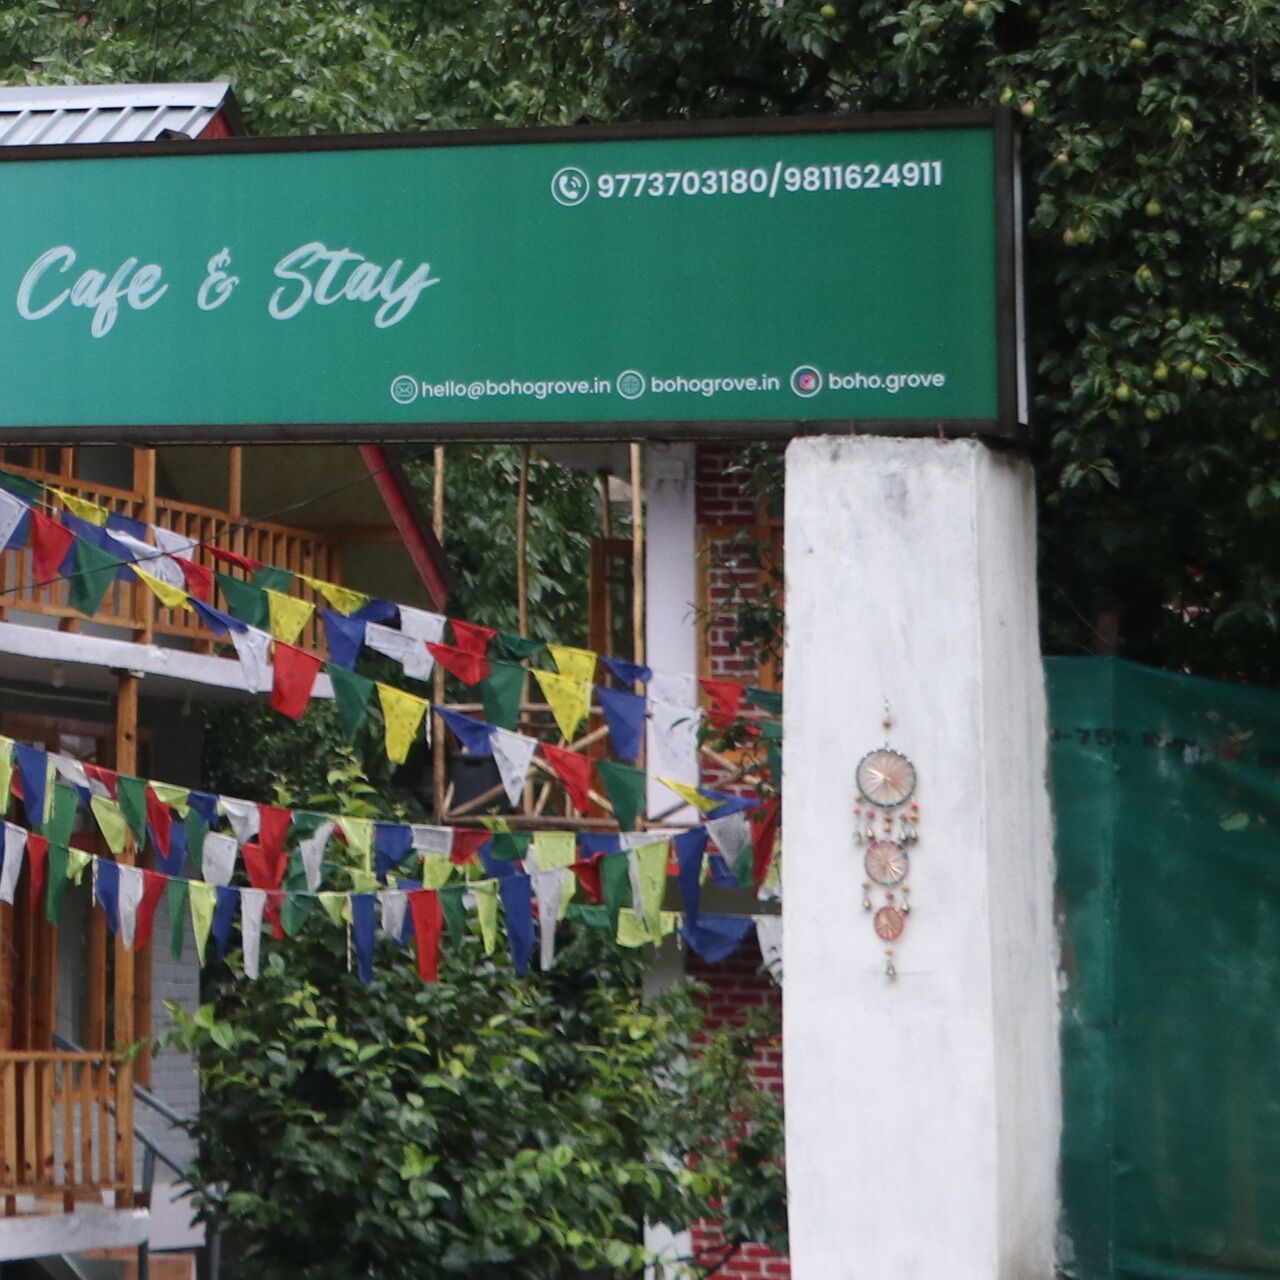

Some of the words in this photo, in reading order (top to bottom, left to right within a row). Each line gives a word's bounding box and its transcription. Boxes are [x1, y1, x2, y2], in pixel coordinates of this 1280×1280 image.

[597, 161, 942, 198] 9773703180/9811624911
[16, 245, 169, 339] Cafe
[196, 247, 240, 312] &
[267, 241, 441, 329] Stay
[421, 377, 611, 399] hello@bohogrove.in
[651, 374, 780, 396] bohogrove.in
[828, 371, 945, 392] boho.grove
